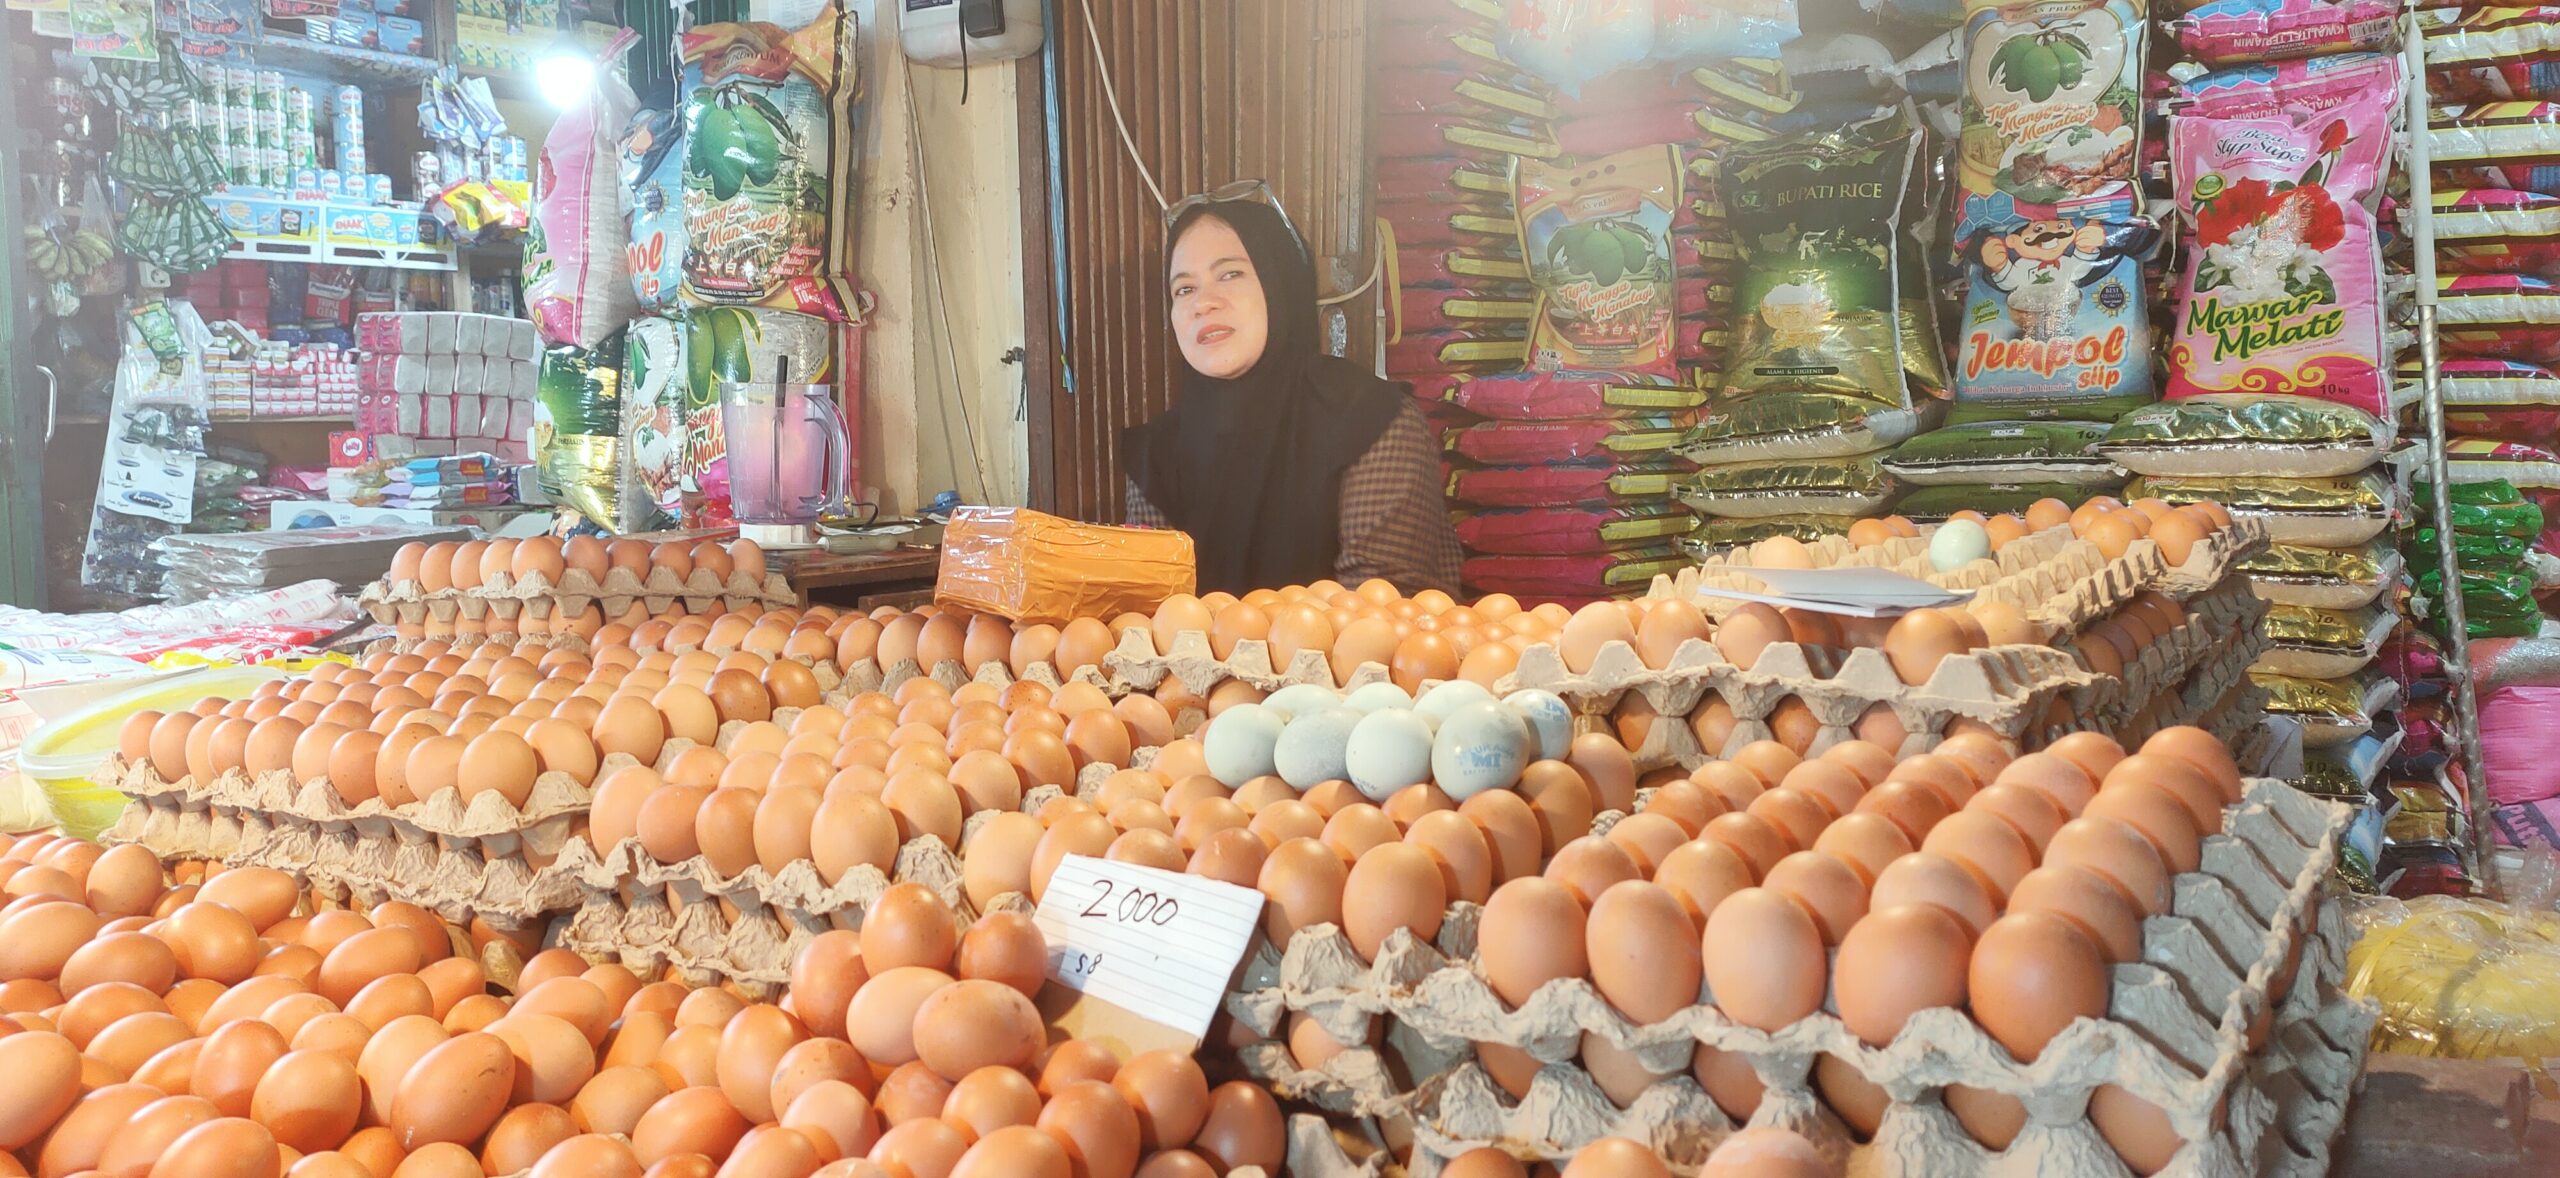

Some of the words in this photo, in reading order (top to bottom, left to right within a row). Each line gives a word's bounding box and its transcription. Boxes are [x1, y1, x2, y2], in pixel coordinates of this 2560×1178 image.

[1985, 102, 2018, 123] Tiga
[1777, 185, 1834, 207] BUPATI
[1839, 182, 1883, 199] RICE
[1559, 281, 1590, 302] Tiga
[1577, 281, 1630, 312] Mangga
[1592, 283, 1654, 321] Manalagi
[2187, 291, 2322, 336] Mawar
[2214, 310, 2345, 362] Melati
[1966, 325, 2126, 380] Jempol
[2320, 383, 2336, 396] 10
[2338, 385, 2350, 396] kg
